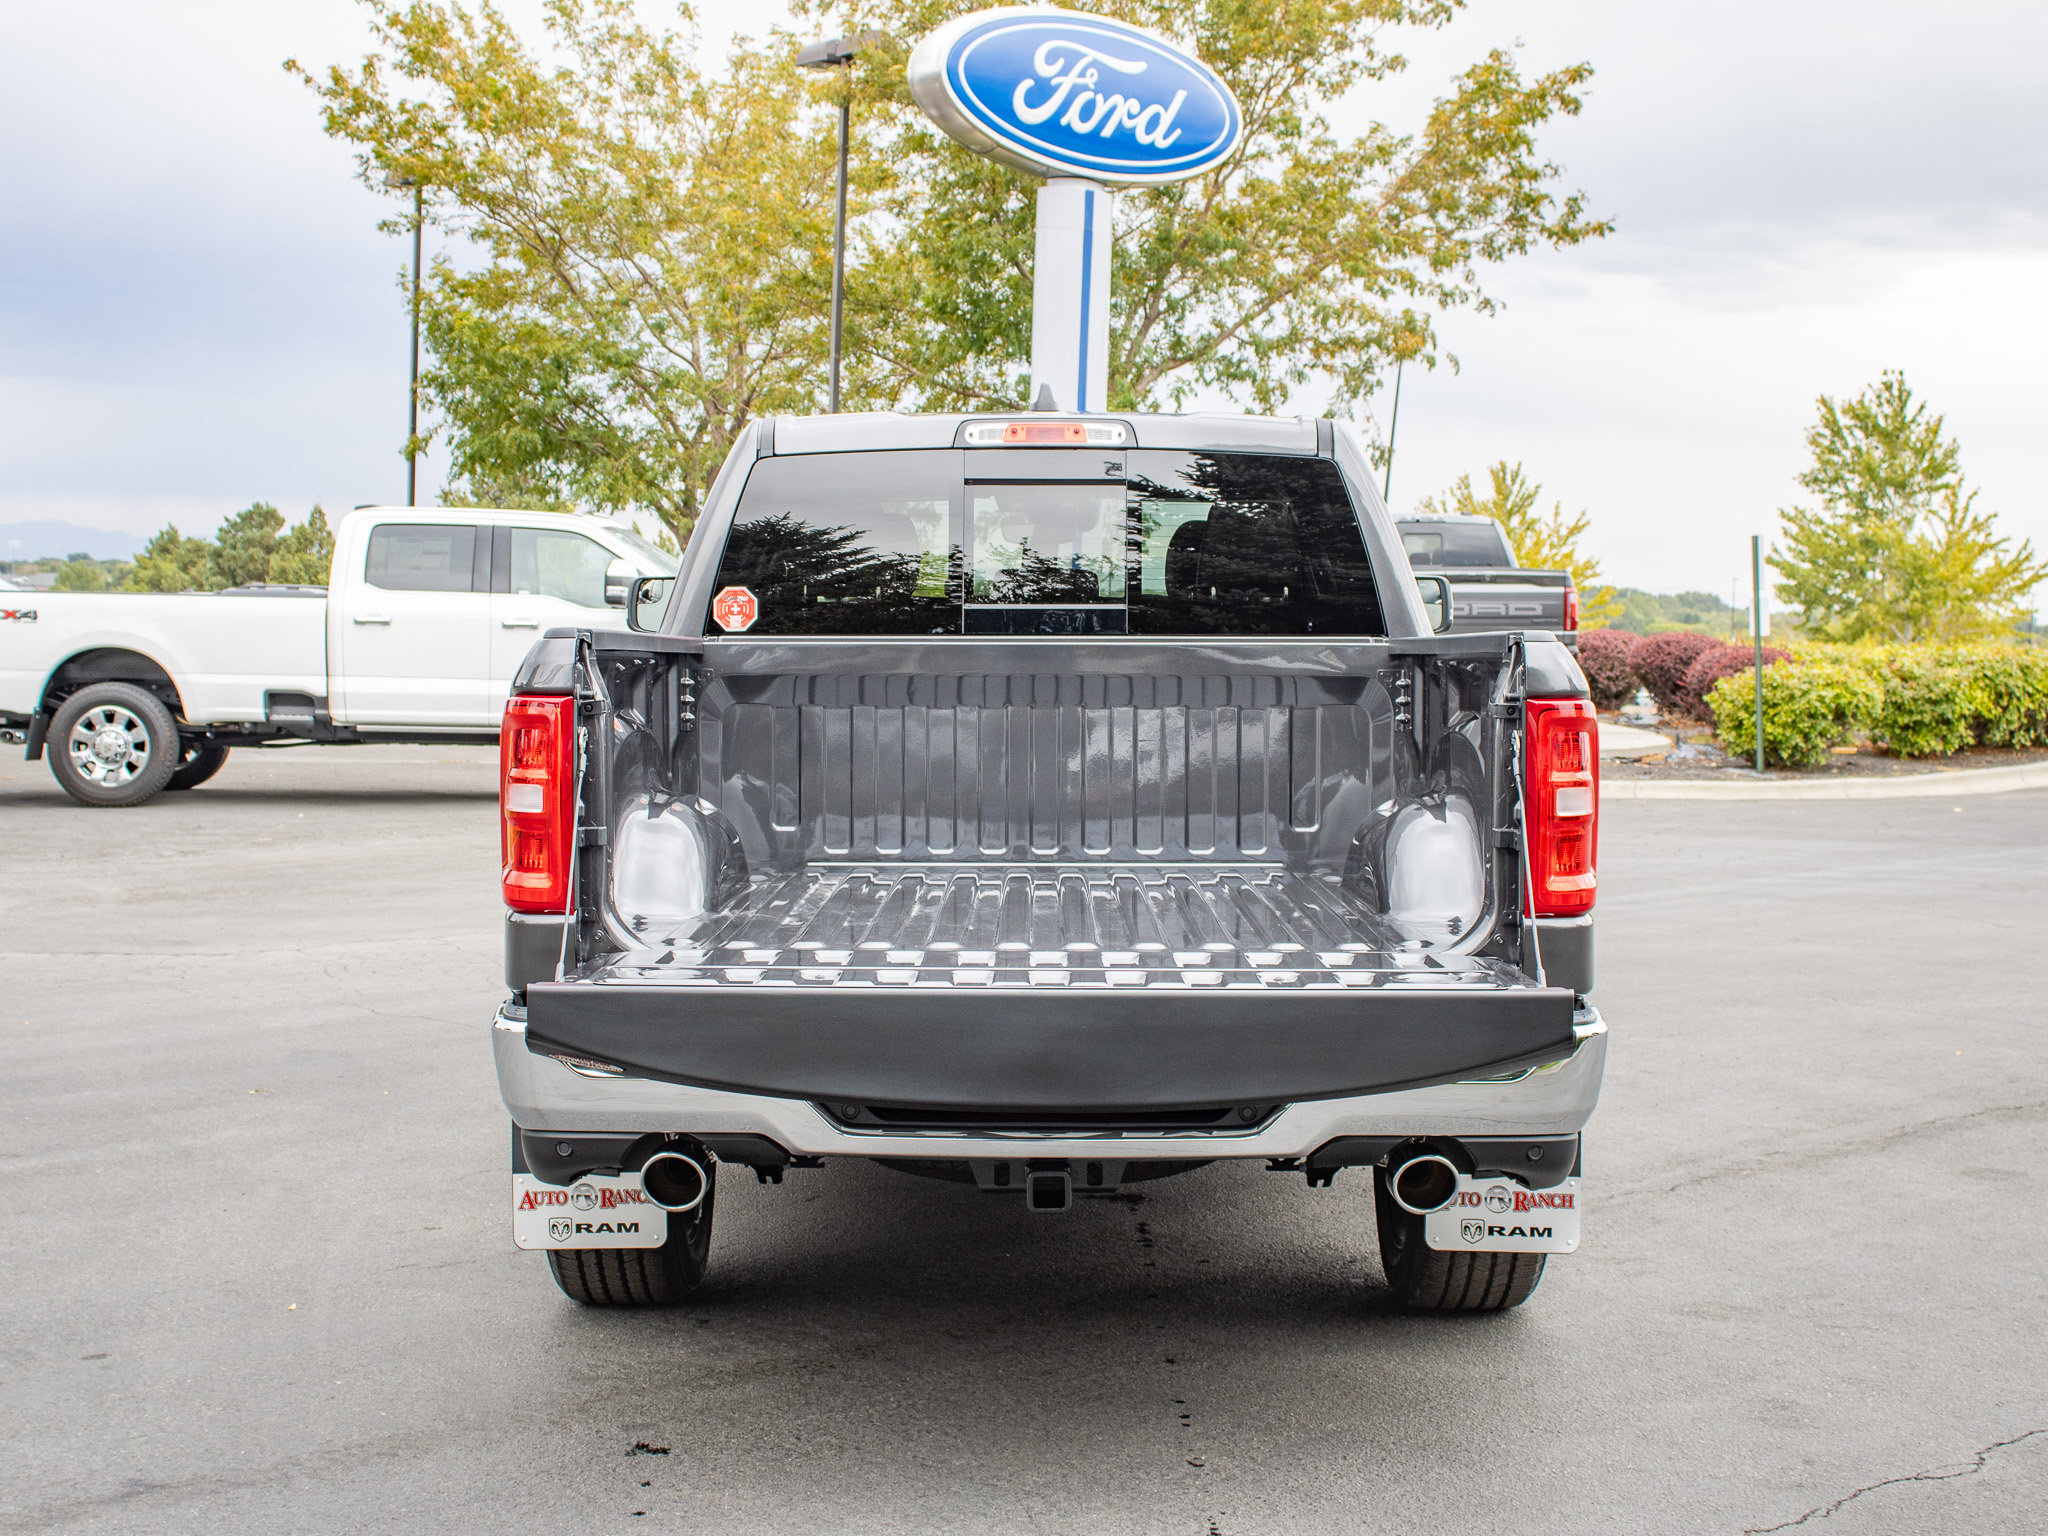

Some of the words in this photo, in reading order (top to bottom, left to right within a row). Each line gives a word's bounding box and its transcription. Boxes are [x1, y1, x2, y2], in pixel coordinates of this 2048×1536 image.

[1013, 40, 1187, 149] Ford
[518, 1190, 568, 1211] AUTO
[599, 1188, 653, 1209] RANC
[1512, 1191, 1575, 1213] RANCH
[575, 1222, 639, 1234] RAM
[1487, 1226, 1553, 1238] RAM
